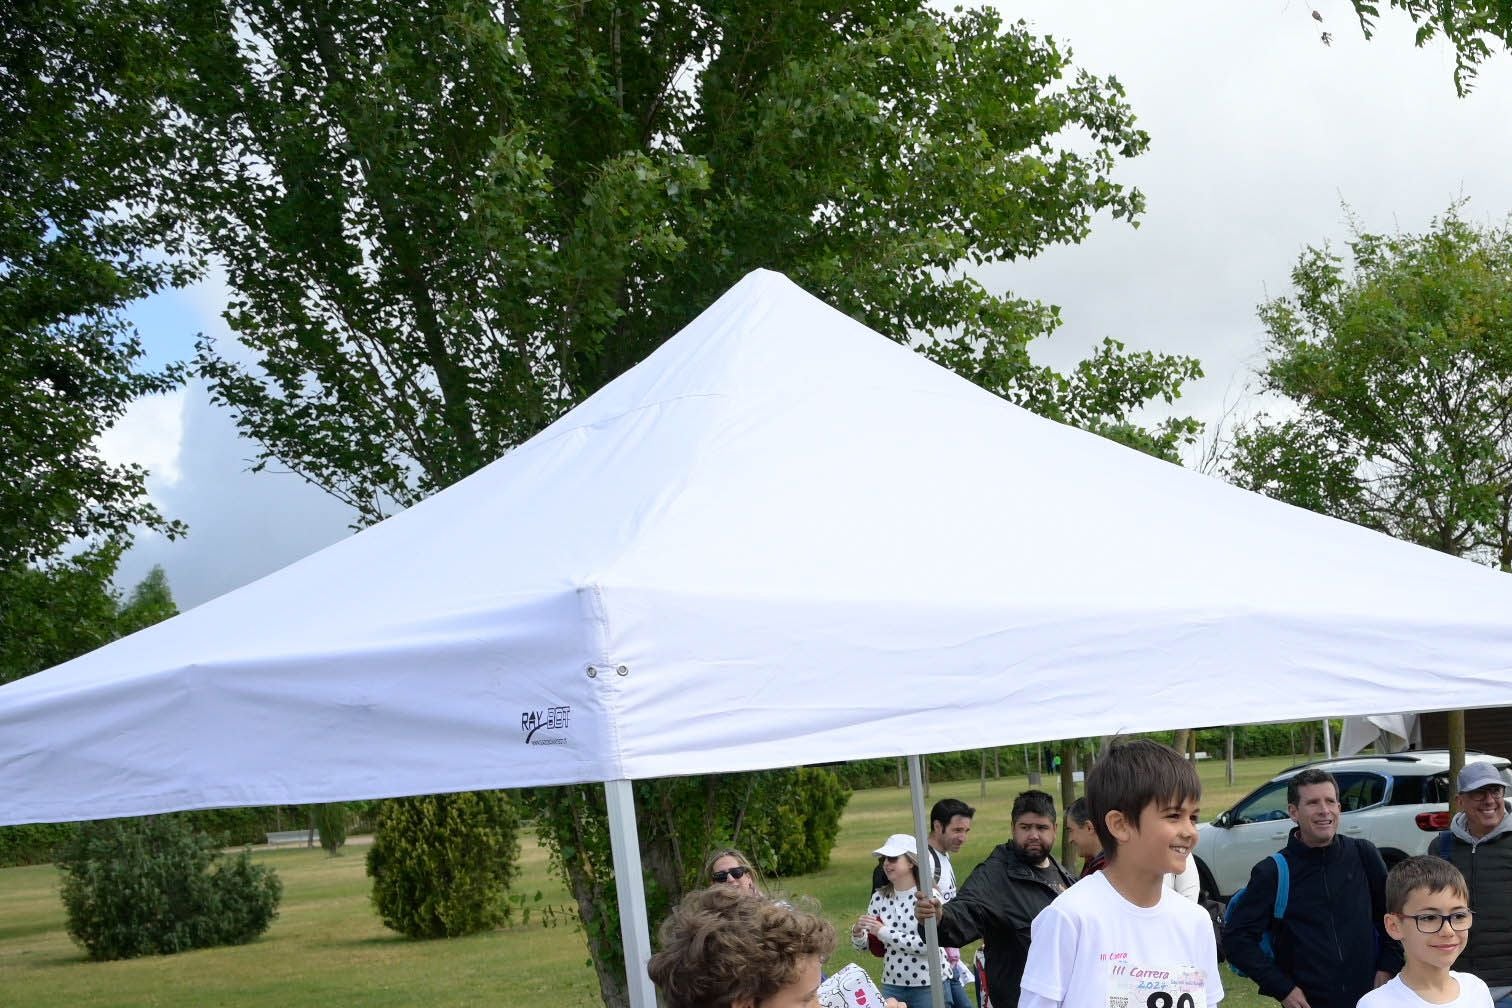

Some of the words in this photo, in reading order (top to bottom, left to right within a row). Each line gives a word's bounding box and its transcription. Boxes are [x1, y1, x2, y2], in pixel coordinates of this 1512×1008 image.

[521, 710, 543, 731] RAY
[1112, 965, 1125, 976] III
[1129, 967, 1170, 979] Carrera
[1137, 981, 1168, 990] 2024
